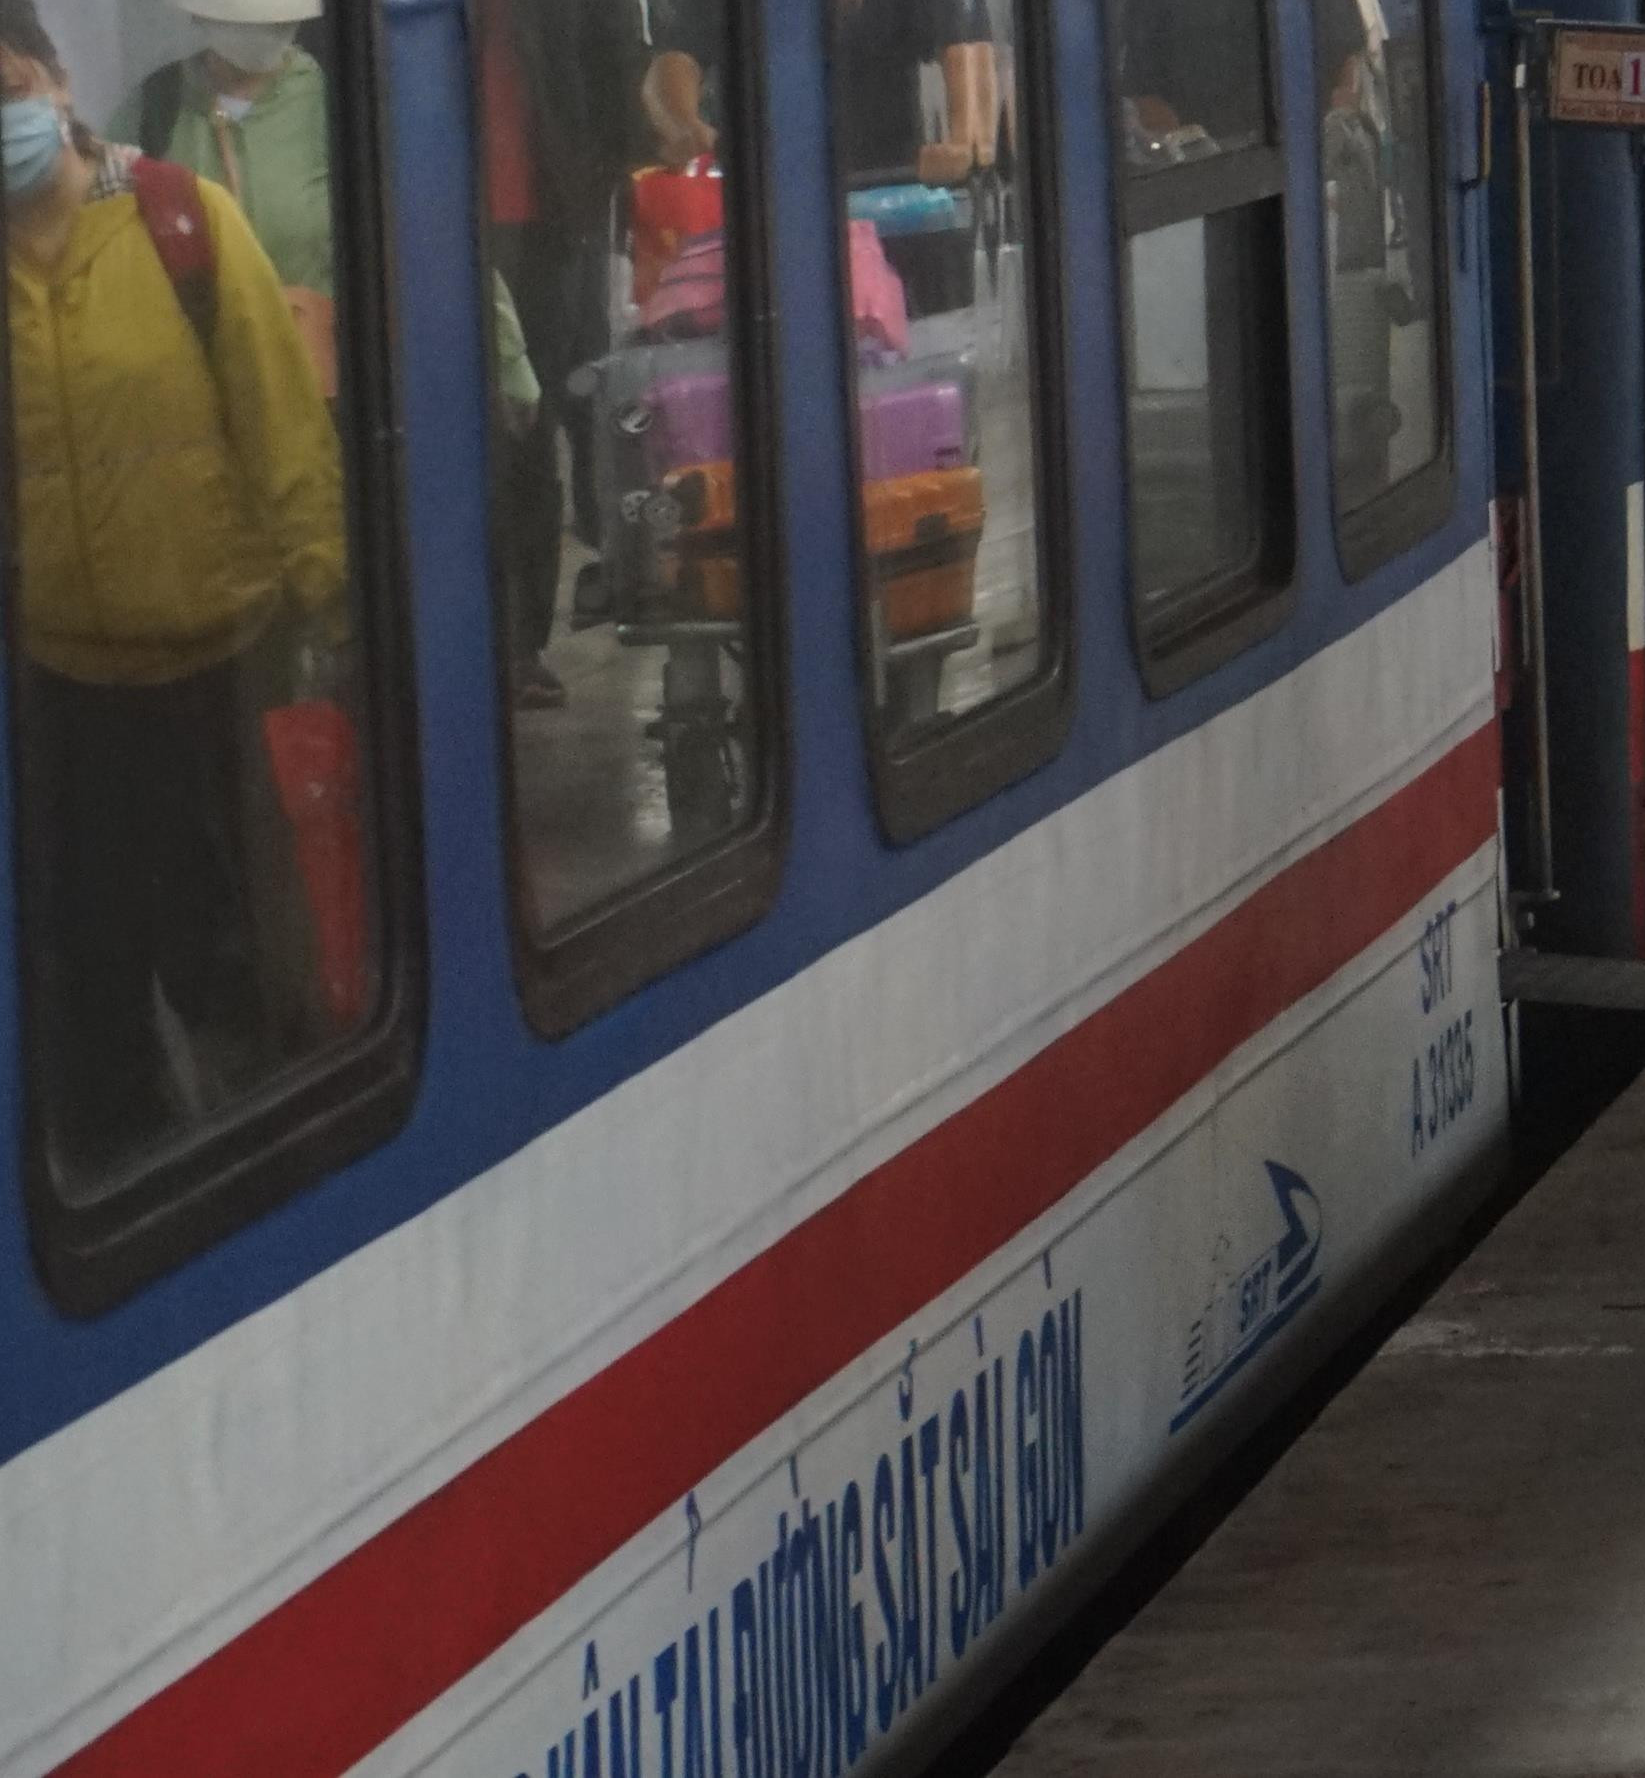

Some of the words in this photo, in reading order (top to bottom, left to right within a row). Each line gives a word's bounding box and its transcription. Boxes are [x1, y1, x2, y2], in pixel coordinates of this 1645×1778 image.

[1420, 898, 1456, 1014] SRT
[1412, 1056, 1425, 1158] A
[873, 1338, 940, 1734] SẮT
[949, 1313, 1006, 1661] SÀI
[1016, 1248, 1084, 1593] GÒN
